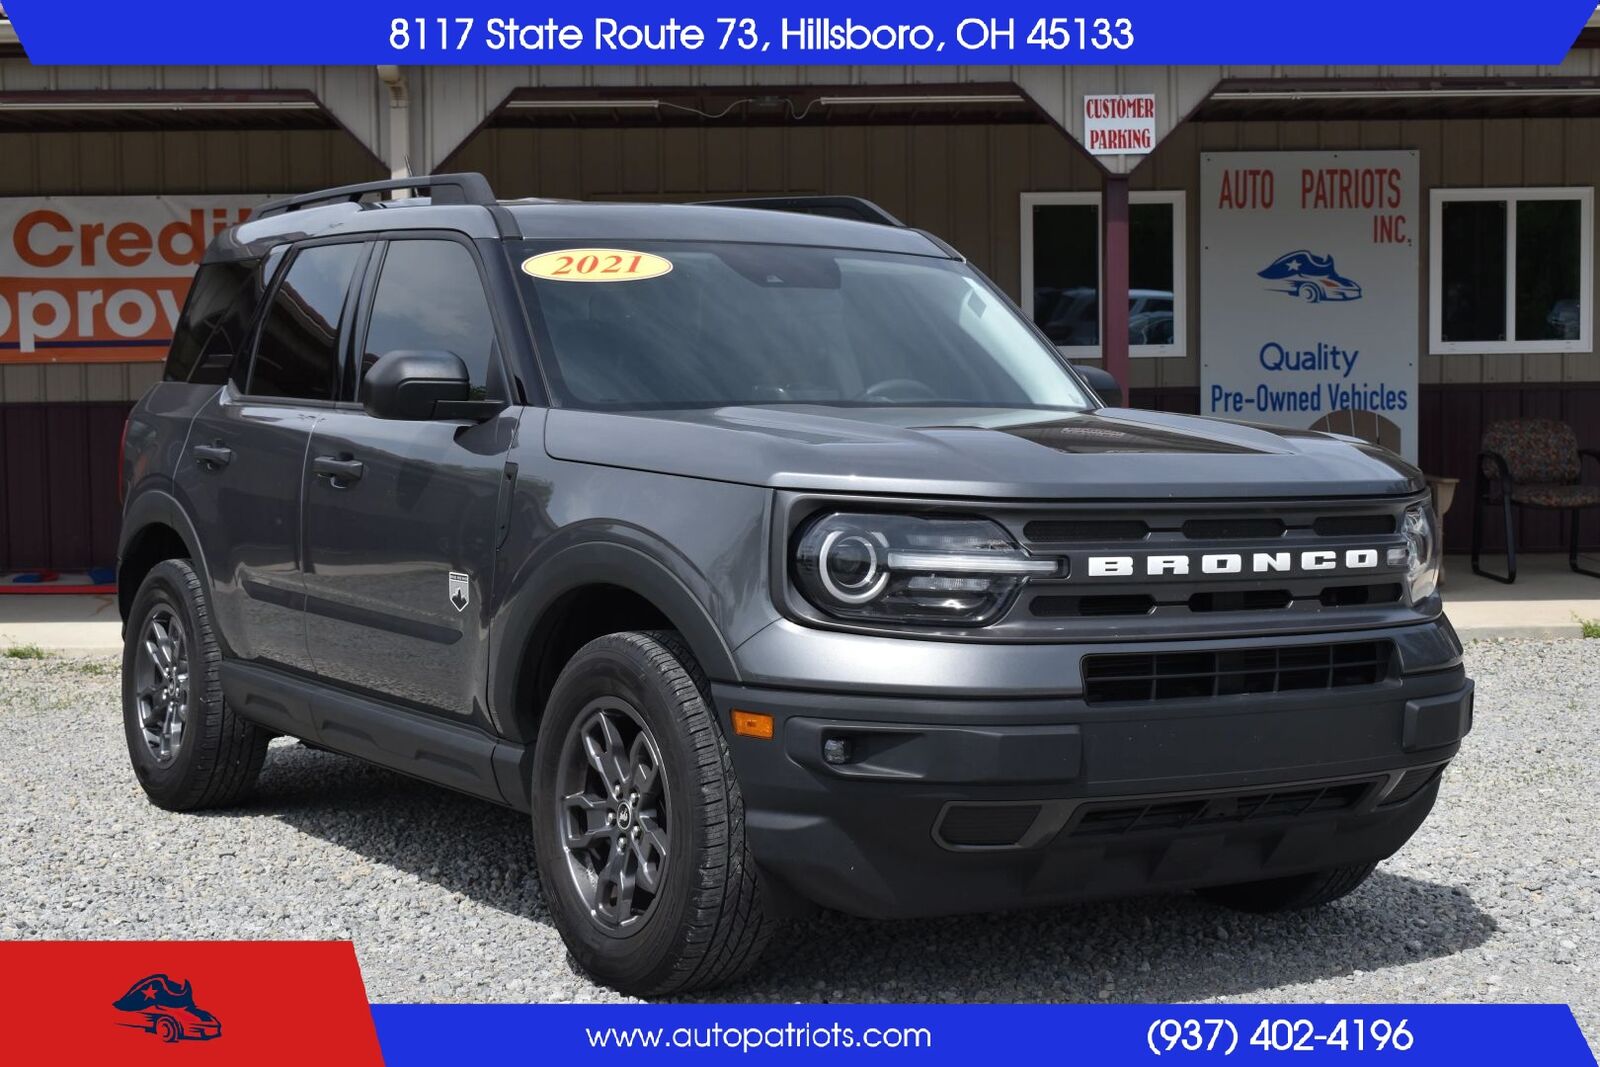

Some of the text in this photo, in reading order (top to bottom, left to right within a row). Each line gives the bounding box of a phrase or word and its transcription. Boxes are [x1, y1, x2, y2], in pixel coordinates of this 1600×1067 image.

[1086, 98, 1154, 118] CUSTOMER
[1090, 129, 1151, 149] PARKING
[1218, 168, 1402, 209] AUTO PATRIOTS
[13, 208, 252, 268] Cred
[551, 254, 642, 276] 2021
[1259, 342, 1359, 378] Quality
[1211, 382, 1408, 413] Pre-Owned Vehicles
[1088, 548, 1379, 578] BRONCO
